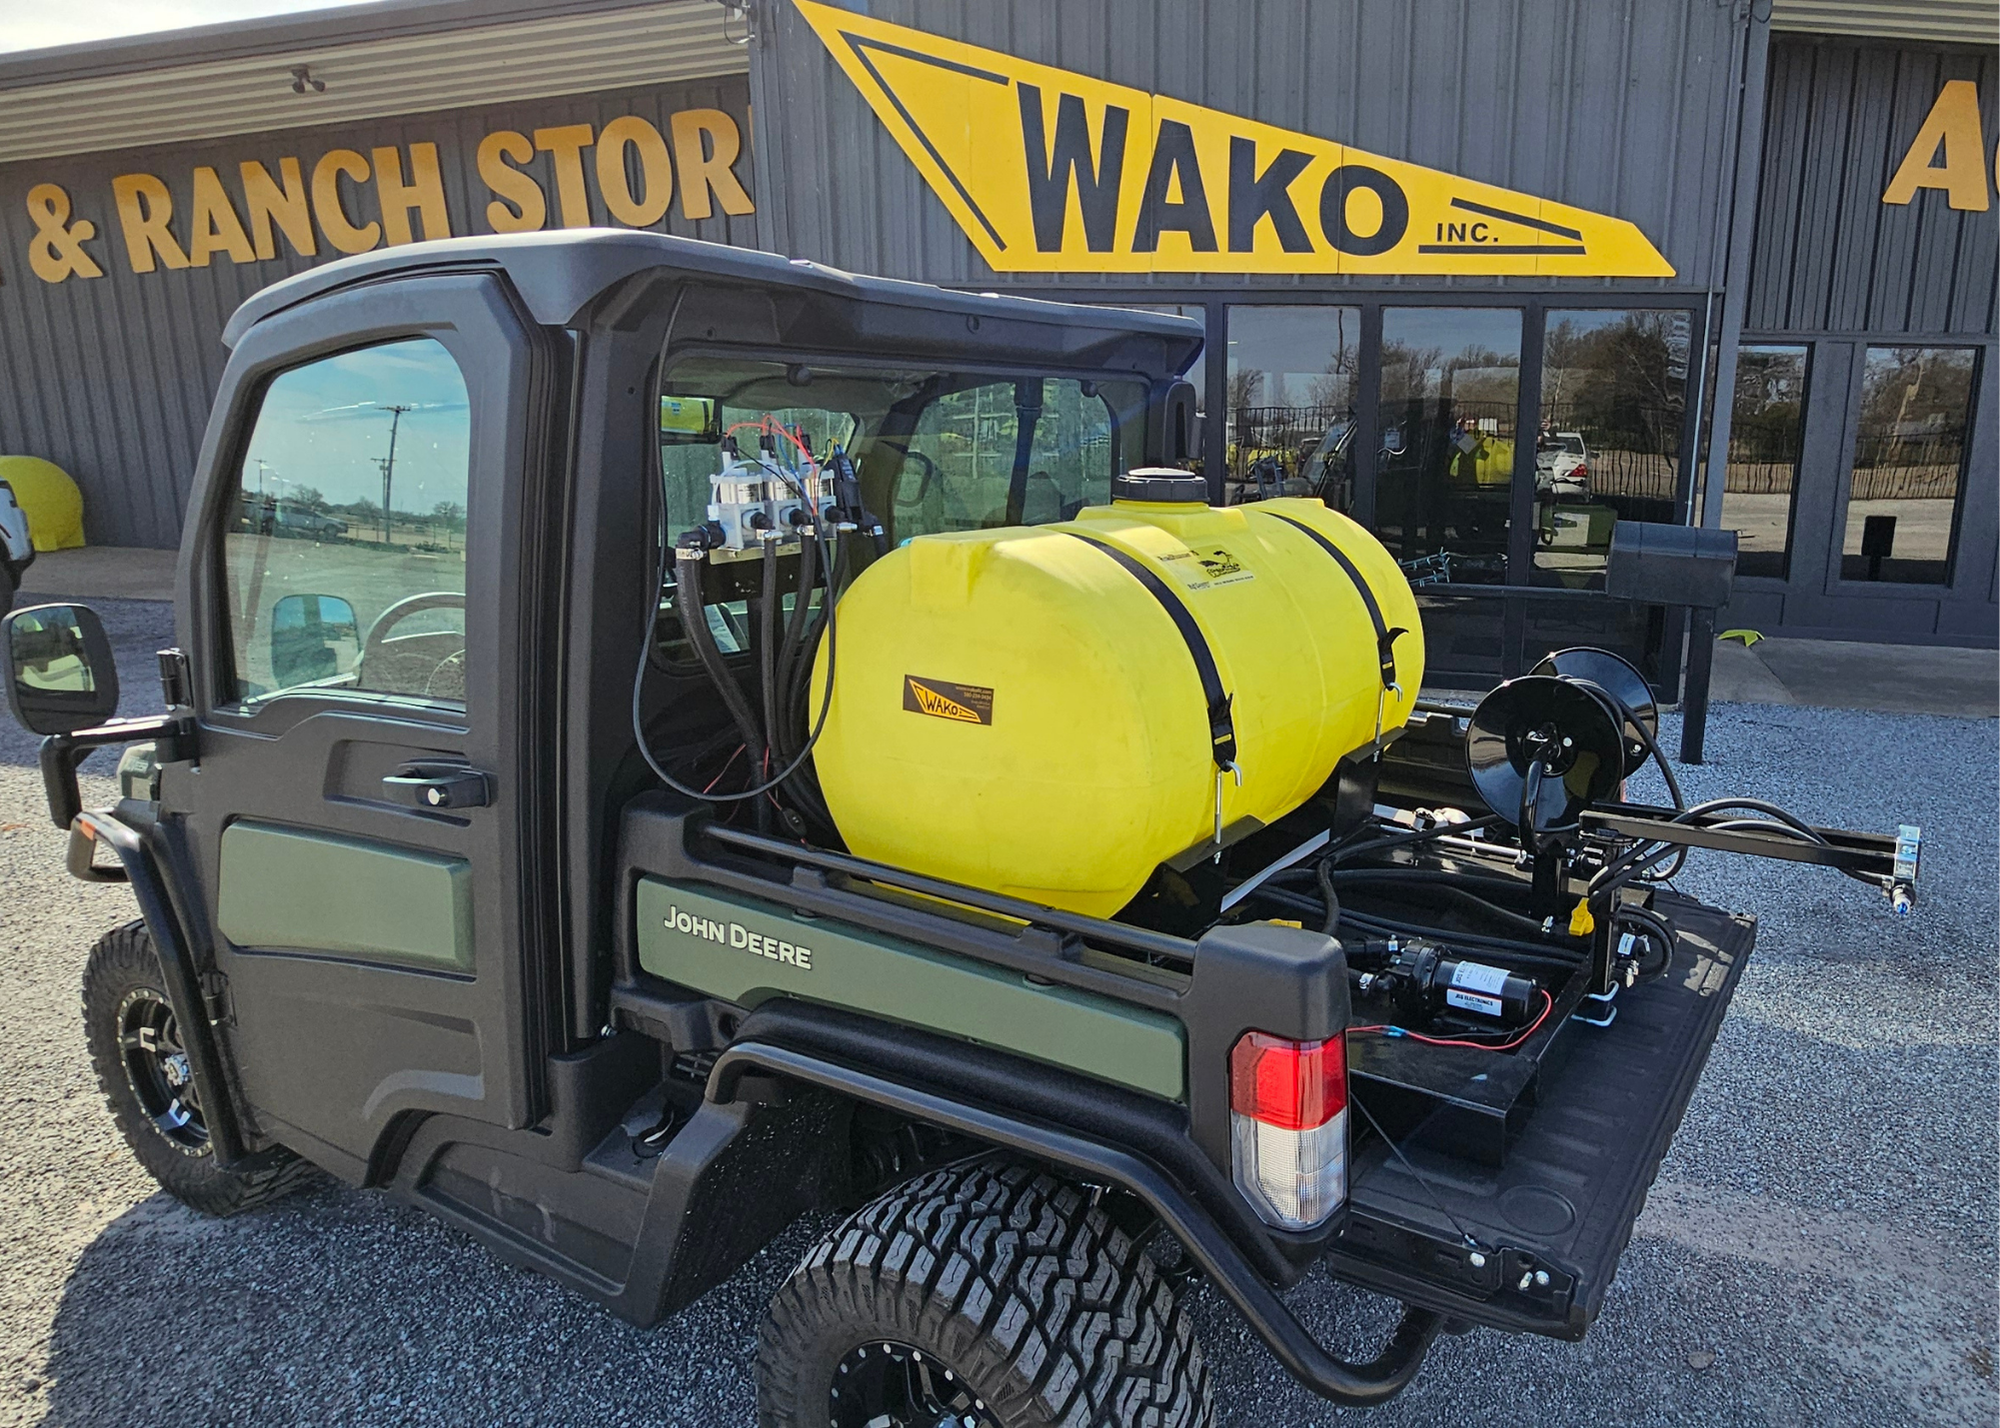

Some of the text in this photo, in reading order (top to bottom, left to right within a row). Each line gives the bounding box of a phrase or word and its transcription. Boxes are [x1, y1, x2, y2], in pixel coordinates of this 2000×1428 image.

[26, 105, 755, 283] & RANCH STOR
[1016, 81, 1499, 257] WAKO INC.
[1882, 79, 1999, 212] A
[925, 690, 958, 716] WAKO
[664, 904, 812, 970] JOHN DEERE
